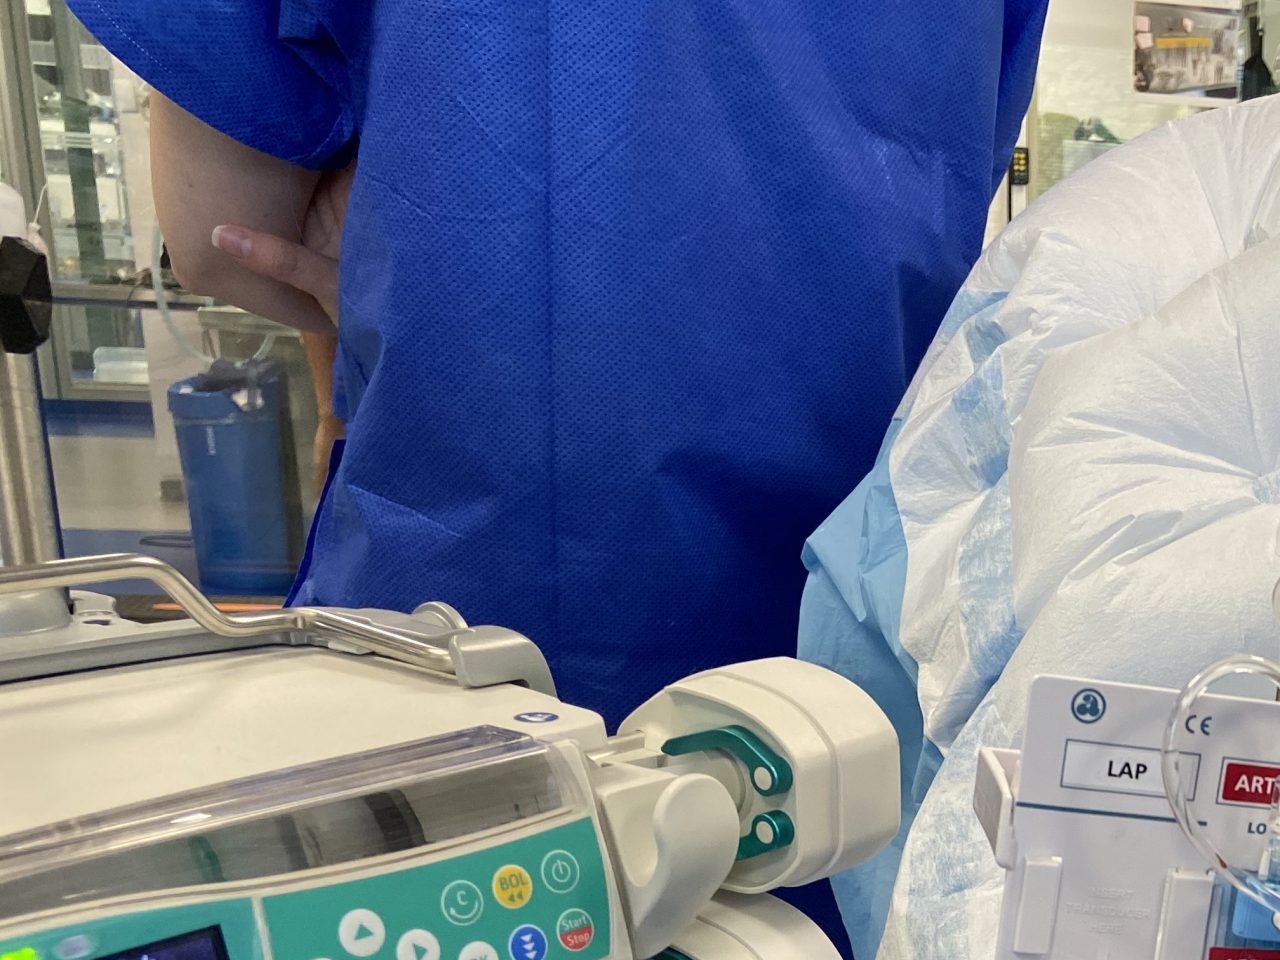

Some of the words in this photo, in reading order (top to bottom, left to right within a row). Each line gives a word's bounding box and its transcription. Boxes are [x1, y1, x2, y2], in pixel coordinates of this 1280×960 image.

[1107, 760, 1148, 780] LAP
[499, 872, 529, 891] BOL
[457, 890, 468, 906] C
[561, 915, 588, 931] Start
[567, 932, 590, 947] Stop
